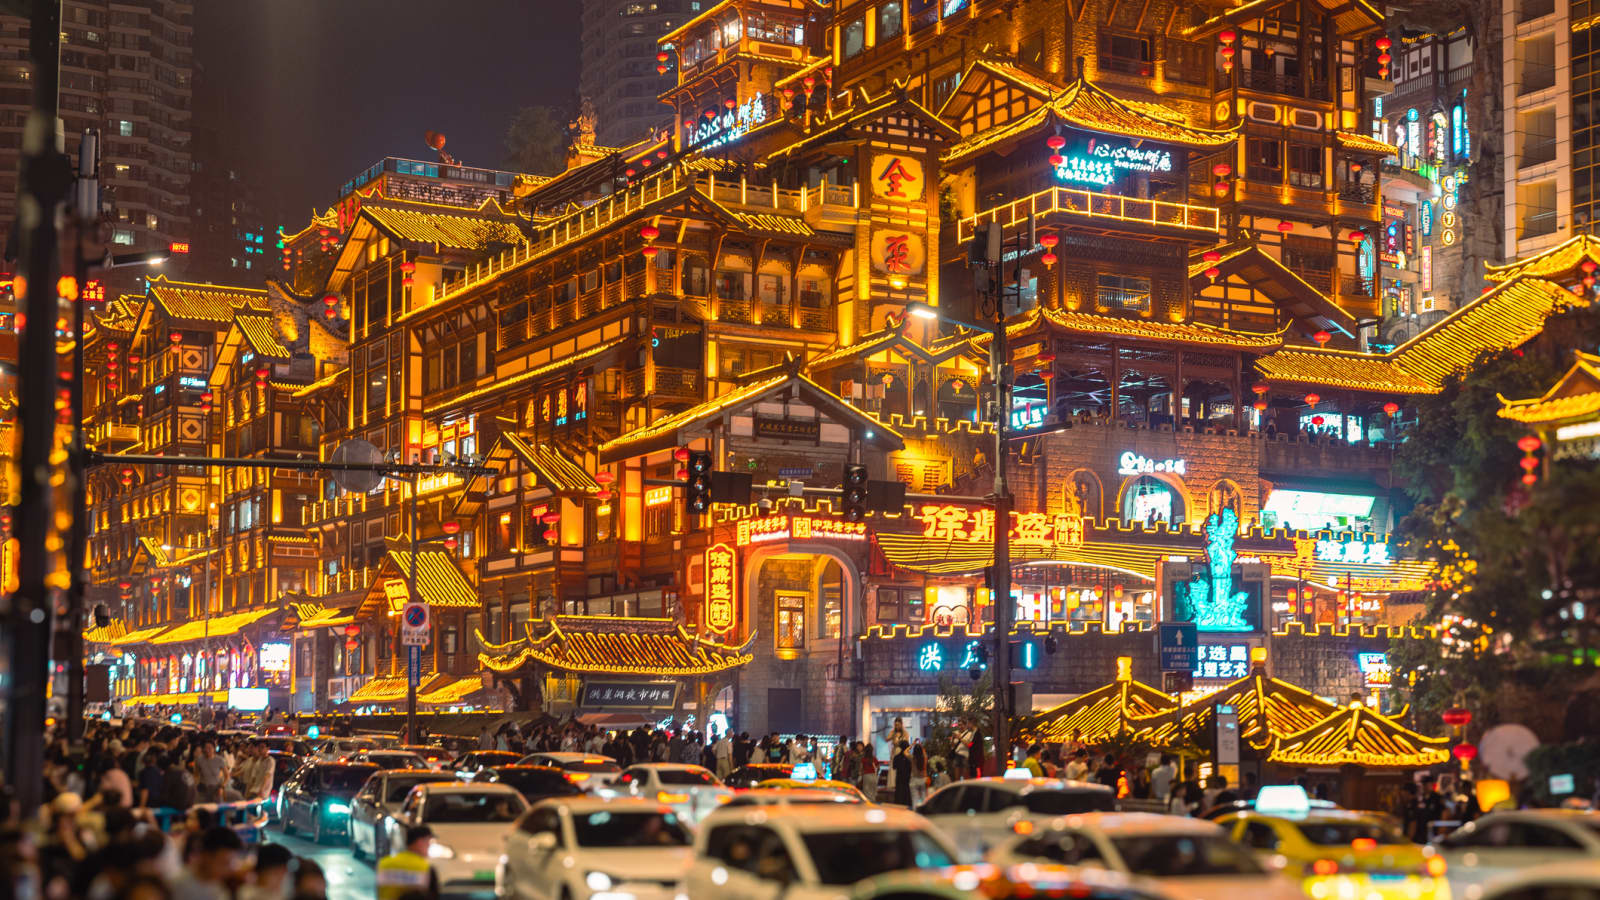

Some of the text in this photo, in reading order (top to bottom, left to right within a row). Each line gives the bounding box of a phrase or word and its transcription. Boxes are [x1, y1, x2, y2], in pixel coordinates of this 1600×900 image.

[812, 520, 866, 533] 中华老字号
